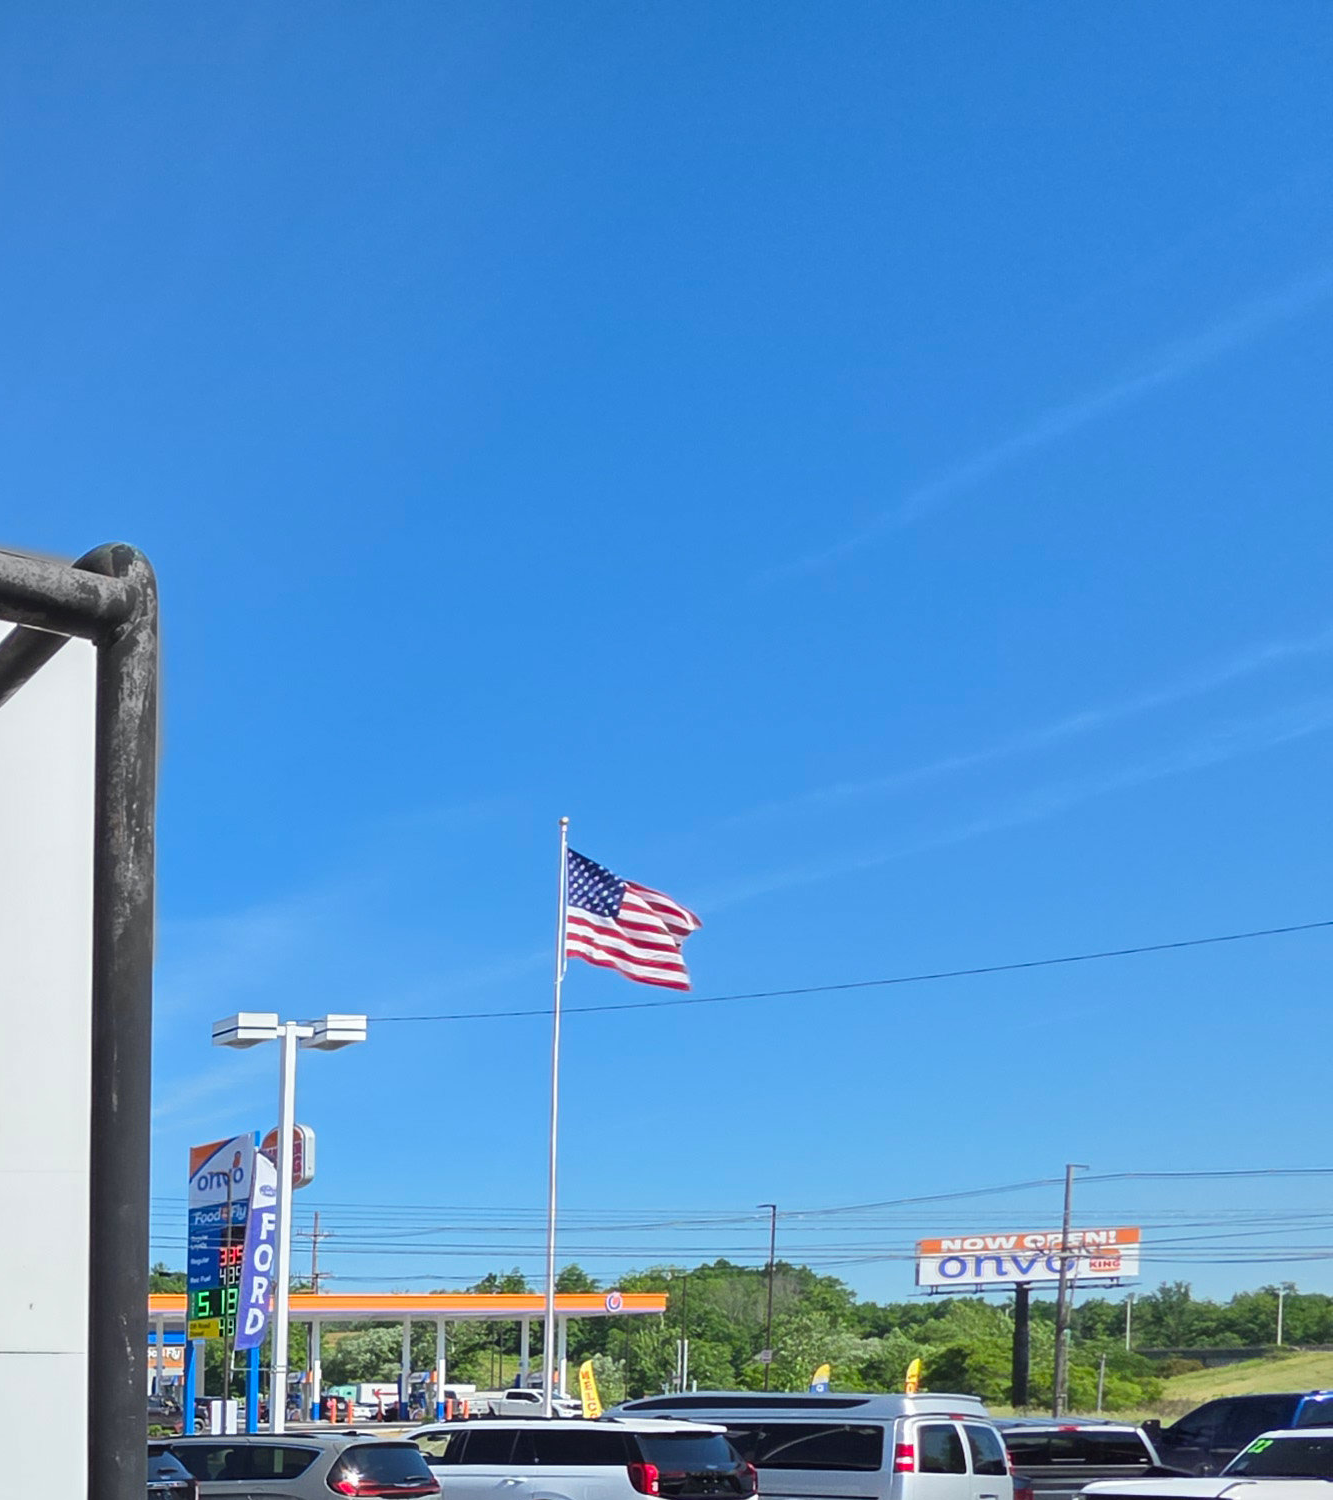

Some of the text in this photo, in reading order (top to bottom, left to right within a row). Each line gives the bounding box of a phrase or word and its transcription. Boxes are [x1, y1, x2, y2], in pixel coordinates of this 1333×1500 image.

[193, 1207, 222, 1225] Food
[940, 1230, 1117, 1252] NOW OPEN!
[244, 1212, 276, 1336] FORD
[938, 1253, 1076, 1278] onvo
[1089, 1260, 1121, 1269] KING
